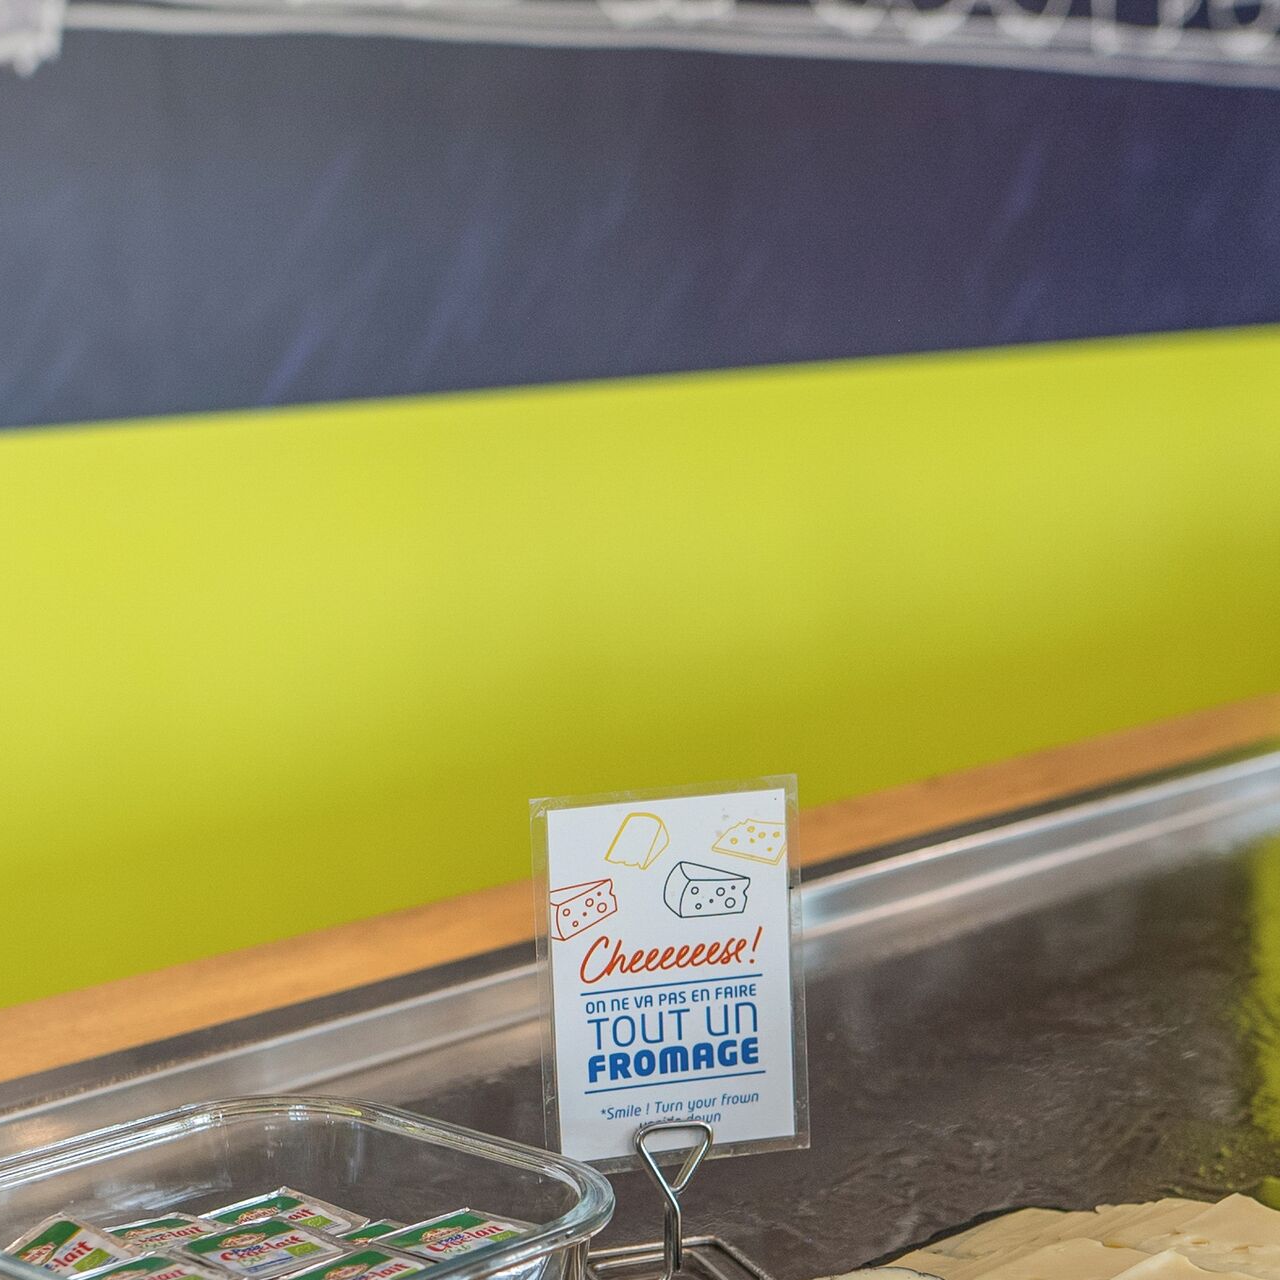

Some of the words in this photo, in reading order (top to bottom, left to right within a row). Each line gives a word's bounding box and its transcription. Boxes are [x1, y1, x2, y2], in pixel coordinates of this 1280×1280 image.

[585, 1000, 606, 1014] ON
[611, 997, 630, 1012] NE
[634, 994, 653, 1008] VA
[658, 991, 687, 1006] PAS
[691, 988, 710, 1003] EN
[715, 983, 757, 1000] FAIRE
[587, 1008, 690, 1050] TOUT
[706, 1001, 758, 1037] UN
[588, 1037, 759, 1084] FROMAGE
[655, 1100, 683, 1114] Turn
[687, 1097, 718, 1113] your
[721, 1092, 759, 1106] frown
